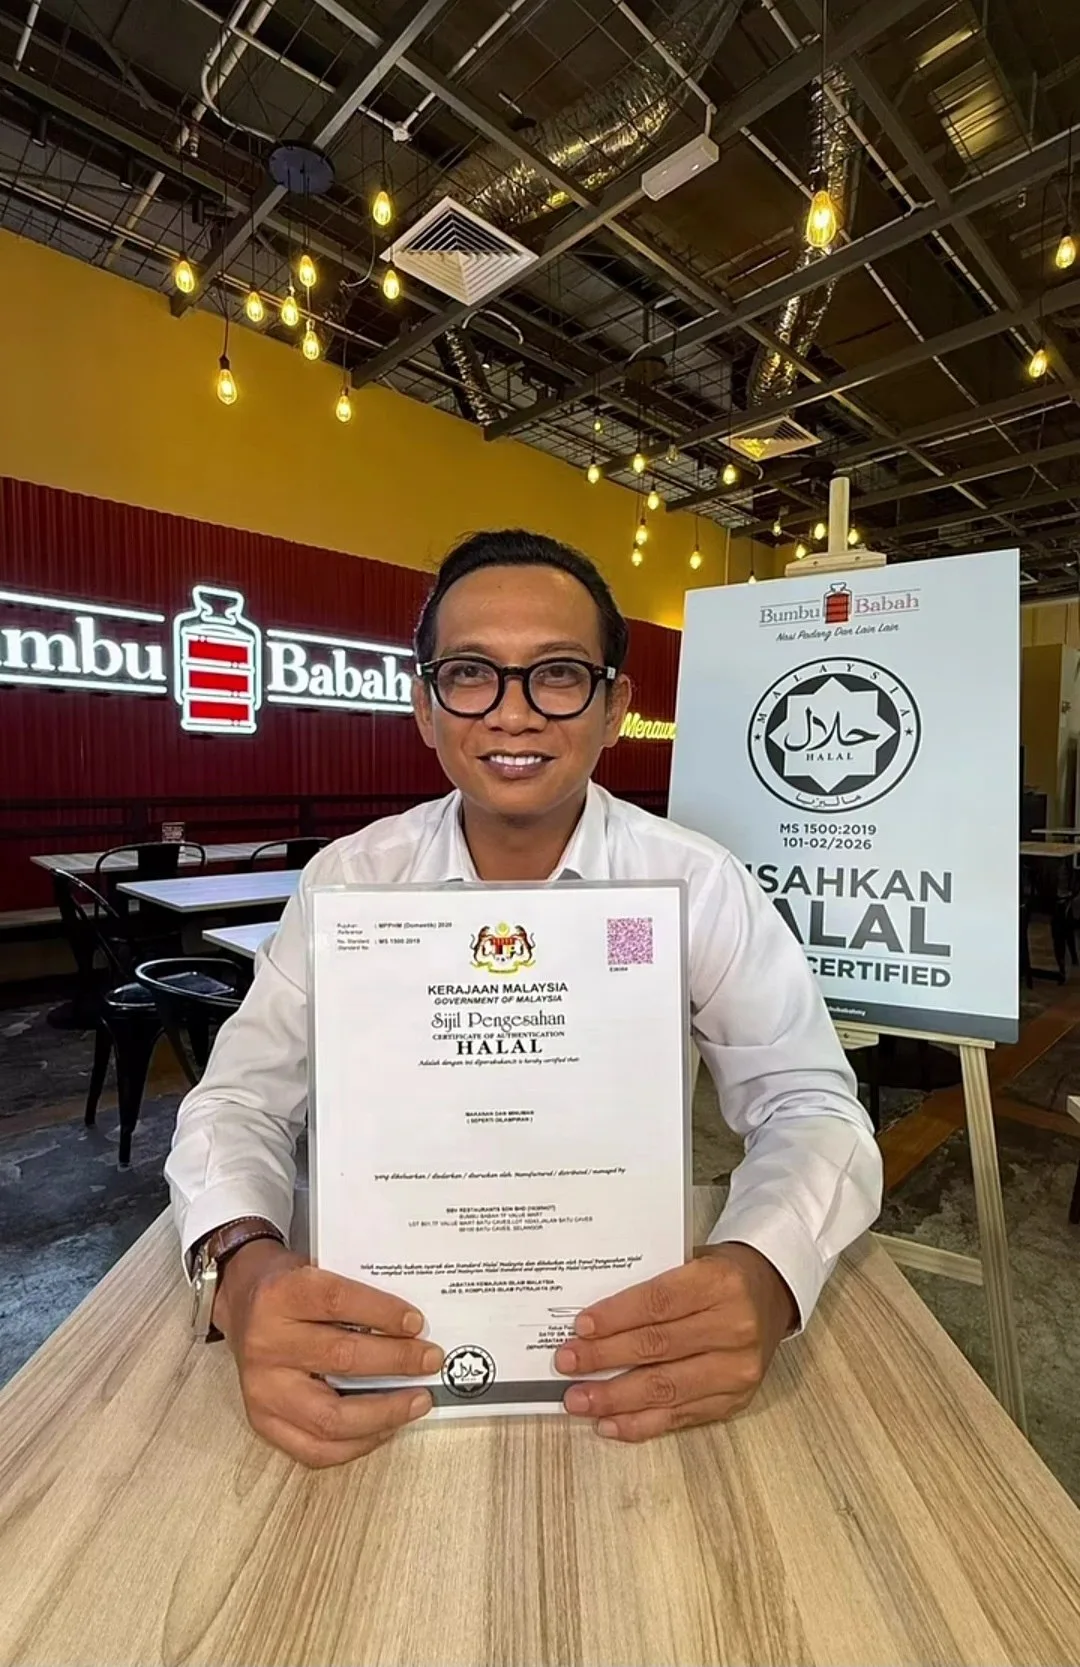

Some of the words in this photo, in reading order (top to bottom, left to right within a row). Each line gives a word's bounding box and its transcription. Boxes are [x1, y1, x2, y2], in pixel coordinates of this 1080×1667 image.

[760, 606, 820, 624] Bumbu
[855, 593, 919, 614] Babah
[776, 632, 797, 642] Nasi
[797, 629, 831, 641] Padang
[834, 626, 853, 637] Dan
[855, 625, 875, 636] Lain
[878, 623, 899, 633] Lain
[0, 617, 167, 681] mbu
[267, 641, 412, 703] Babah
[757, 663, 910, 724] MALAYSIA
[784, 706, 881, 752] حلال
[806, 752, 854, 761] HALAL
[779, 823, 799, 834] MS
[804, 824, 877, 835] 1500:2019
[783, 837, 872, 850] 101-02/2026
[745, 863, 952, 903] SAHKAN
[427, 984, 499, 996] KERAJAAN
[502, 982, 569, 993] MALAYSIA
[434, 996, 499, 1005] GOVERNMENT
[516, 994, 562, 1003] MALAYSIA
[431, 1011, 461, 1032] Sijil
[468, 1009, 566, 1033] Pengesahan
[496, 1031, 566, 1039] AUTHENTICATION
[456, 1038, 543, 1056] HALAL
